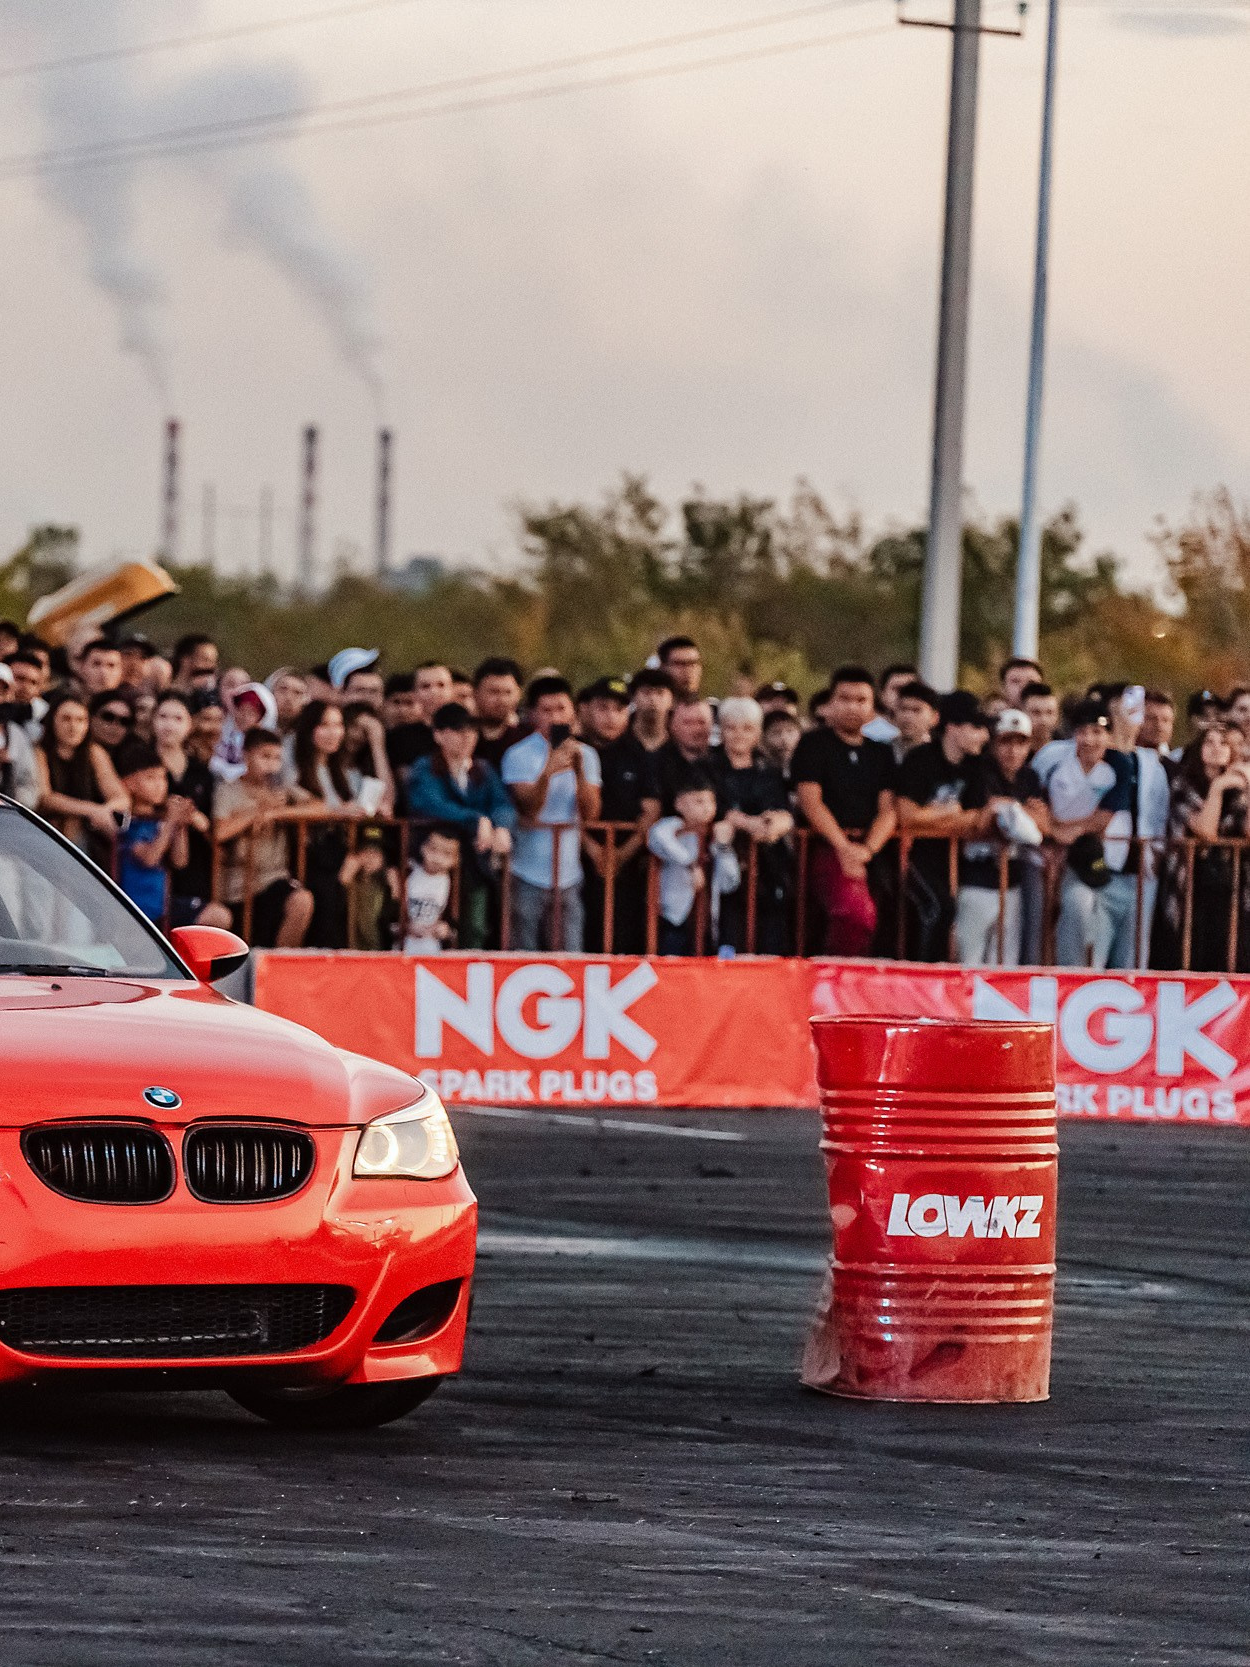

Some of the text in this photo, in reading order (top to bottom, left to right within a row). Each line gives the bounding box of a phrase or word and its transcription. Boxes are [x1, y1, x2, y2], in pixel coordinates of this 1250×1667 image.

[414, 960, 659, 1063] NGK
[416, 1068, 659, 1102] SPARK PLUGS
[1106, 1084, 1238, 1121] PLUGS
[886, 1193, 1044, 1239] LOWKZ
